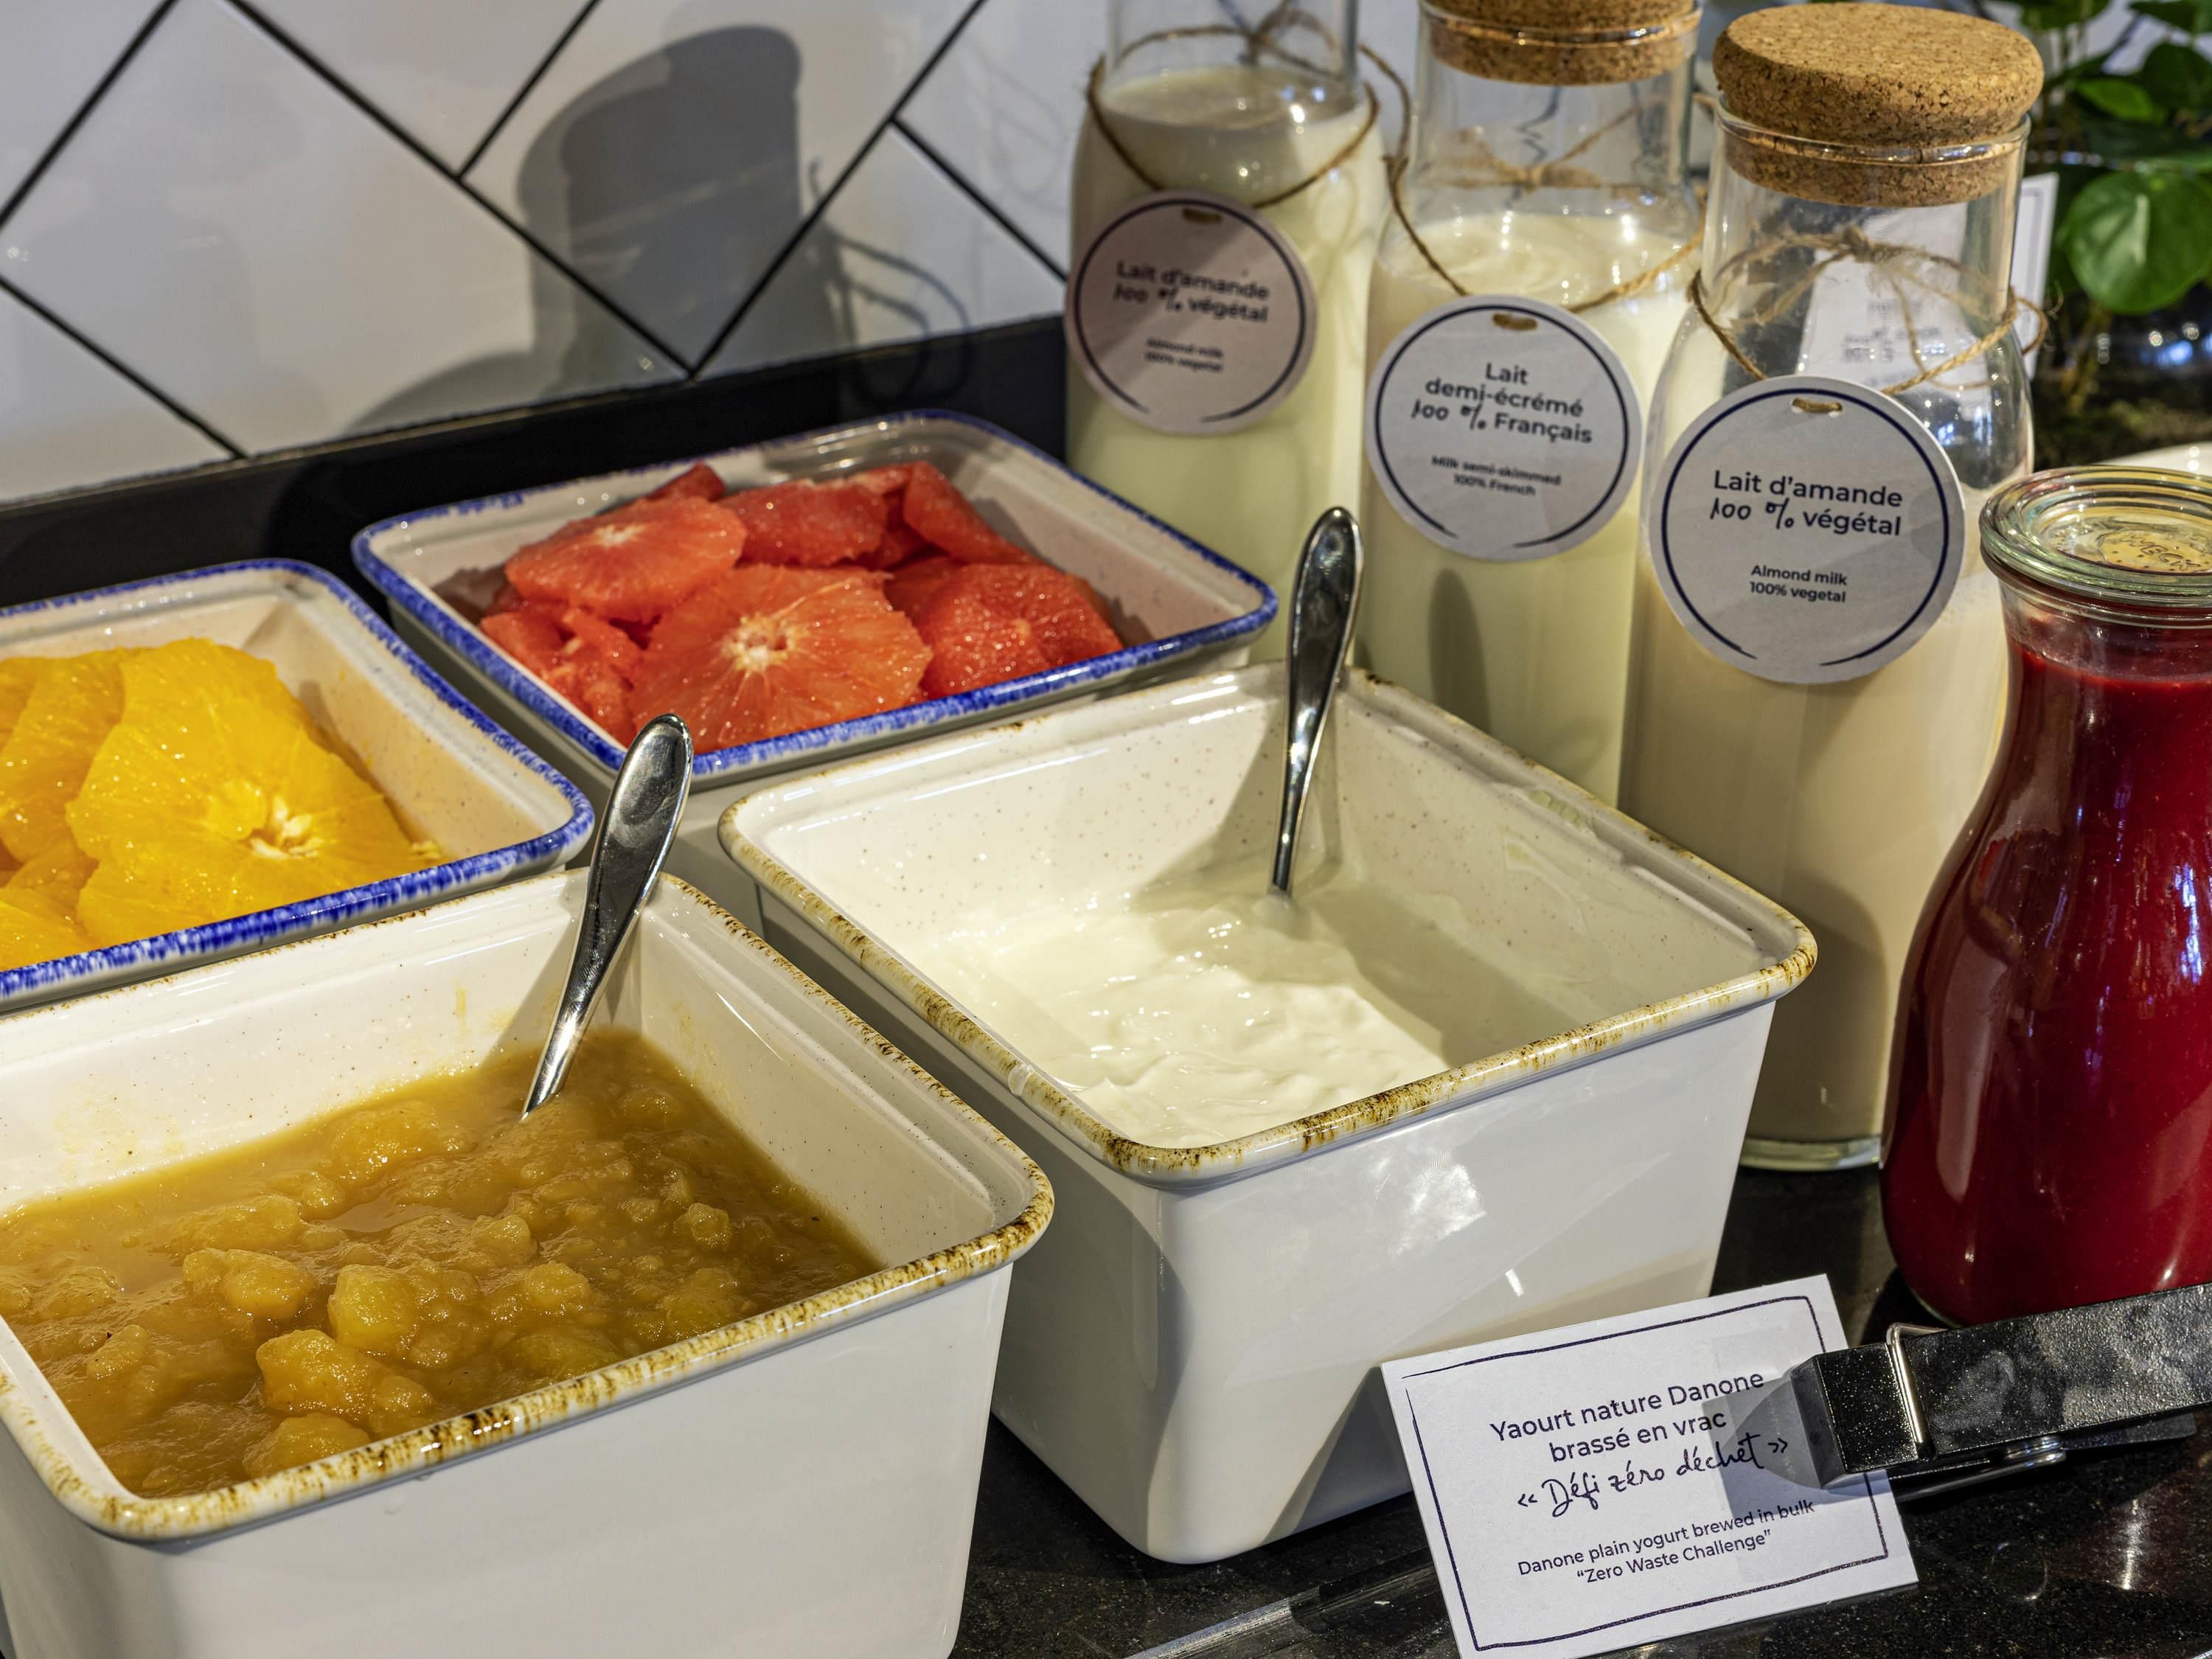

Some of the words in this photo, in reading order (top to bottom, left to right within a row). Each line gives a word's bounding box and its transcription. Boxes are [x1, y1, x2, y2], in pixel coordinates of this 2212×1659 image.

[1116, 260, 1155, 283] Lait
[1161, 268, 1270, 300] d’amande
[1188, 296, 1268, 323] végétal
[1486, 363, 1528, 385] Lait
[1425, 378, 1584, 417] demi-écrémé
[1411, 400, 1449, 421] 100
[1494, 412, 1593, 443] Français
[1432, 455, 1458, 470] Milk
[1462, 459, 1562, 485] semi-skimmed
[1454, 475, 1486, 489] 100%
[1490, 479, 1536, 496] French
[1714, 470, 1761, 493] Lait
[1770, 476, 1903, 507] d’amande
[1710, 497, 1751, 520] 100
[1803, 508, 1901, 536] végétal
[1750, 582, 1787, 597] 100%
[1790, 587, 1846, 602] vegetal
[1751, 565, 1811, 582] Almond
[1815, 572, 1847, 585] milk
[1489, 1409, 1576, 1441] Yaourt
[1581, 1394, 1663, 1424] nature
[1668, 1373, 1764, 1405] Danone
[1549, 1427, 1630, 1462] brassé
[1637, 1425, 1668, 1444] en
[1673, 1413, 1727, 1436] vrac
[1541, 1472, 1600, 1517] Défi
[1607, 1460, 1665, 1492] zéro
[1676, 1432, 1764, 1475] déchet
[1518, 1552, 1585, 1575] Danone
[1588, 1540, 1630, 1563] plain
[1632, 1527, 1689, 1554] yogurt
[1691, 1512, 1754, 1537] brewed
[1758, 1509, 1775, 1523] in
[1777, 1499, 1815, 1519] bulk
[1577, 1566, 1623, 1583] “Zero
[1626, 1553, 1679, 1573] Waste
[1683, 1529, 1770, 1561] Challenge”
